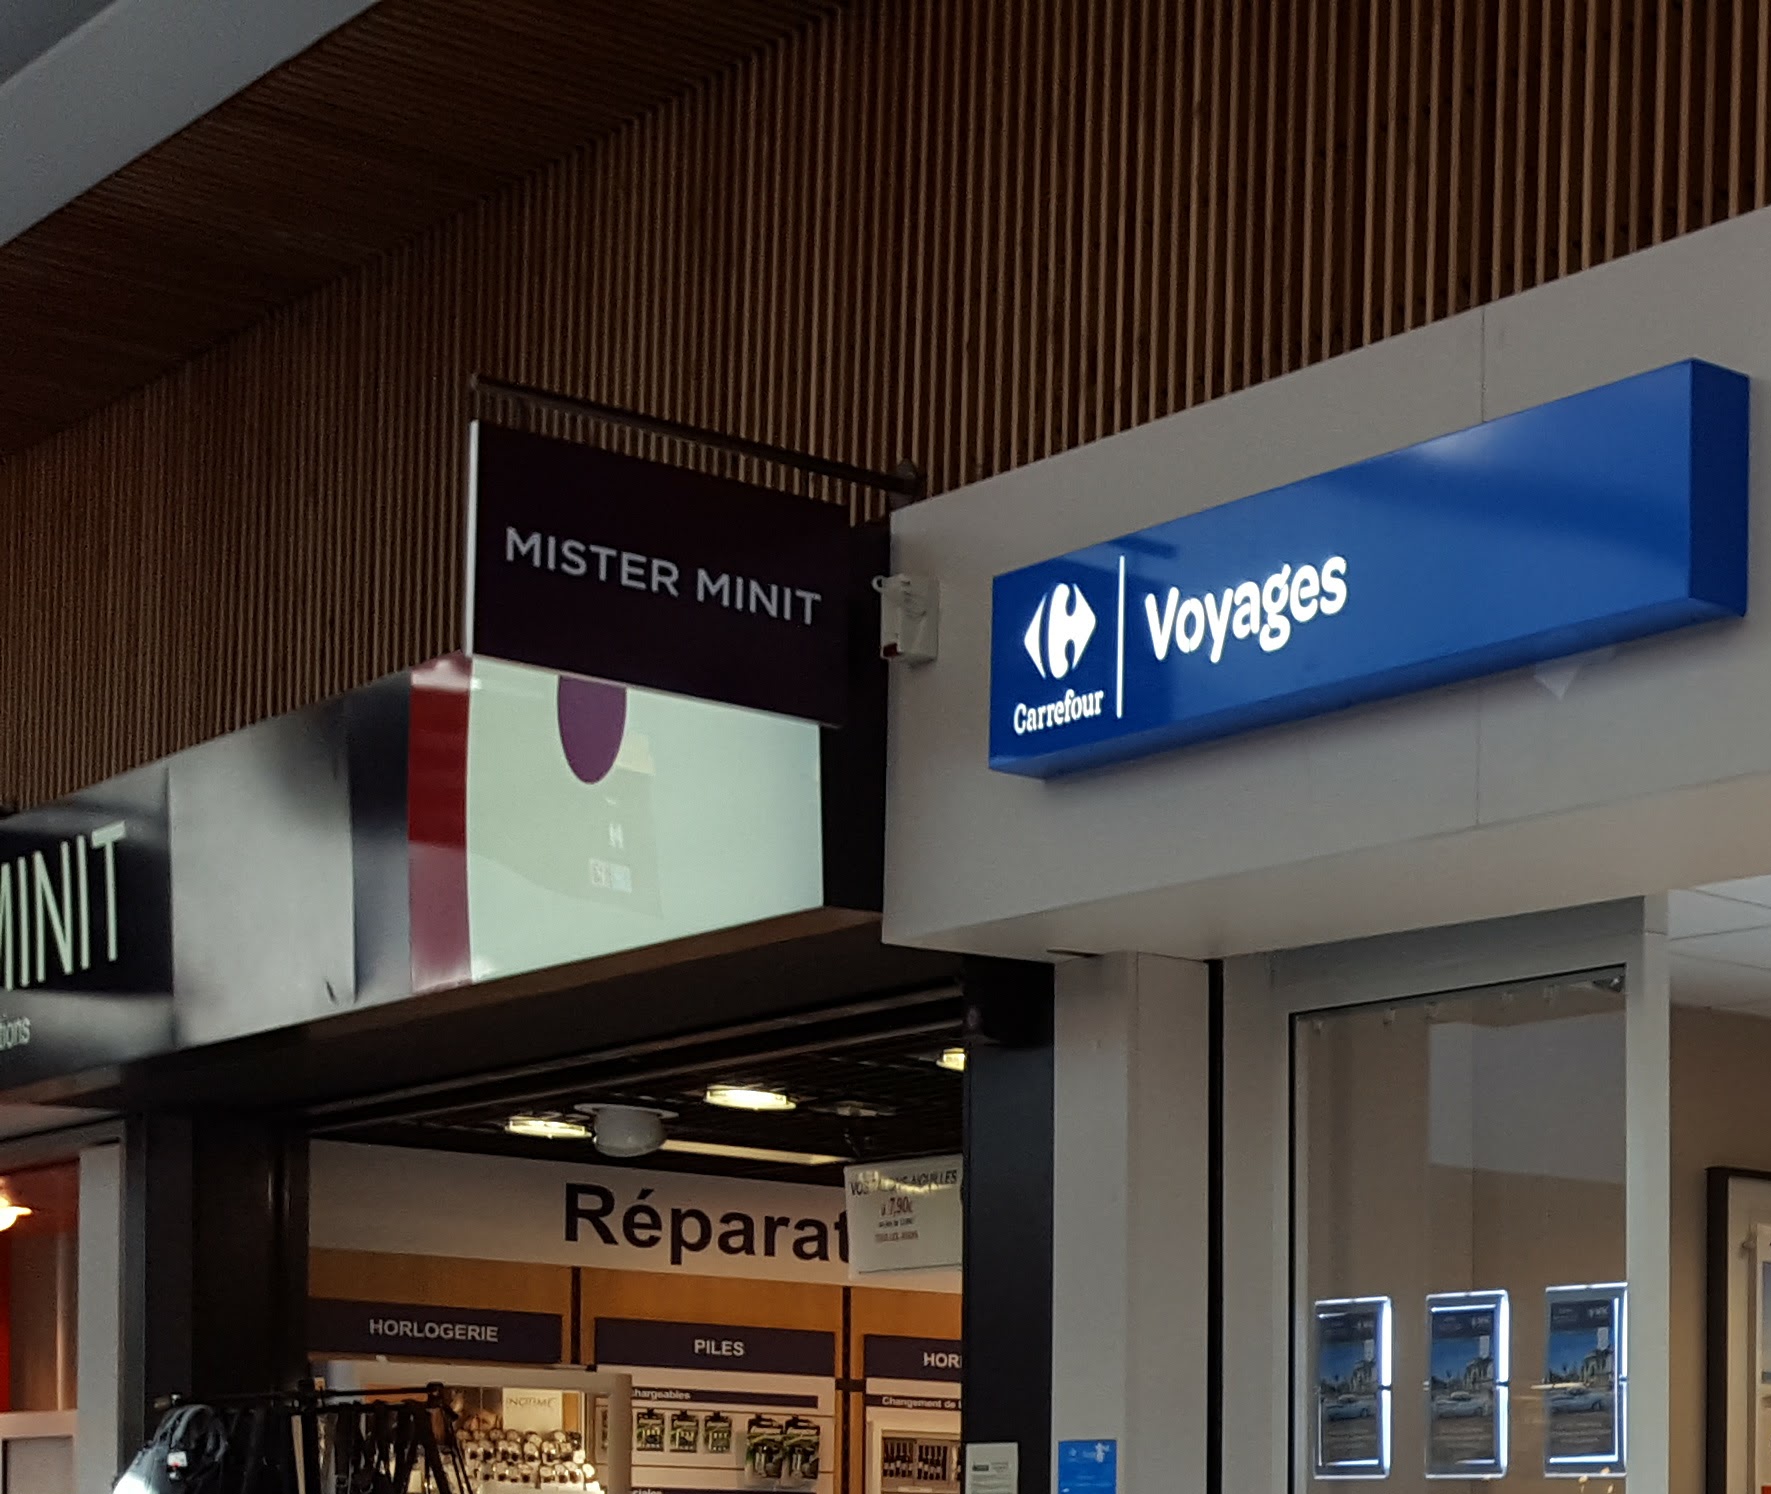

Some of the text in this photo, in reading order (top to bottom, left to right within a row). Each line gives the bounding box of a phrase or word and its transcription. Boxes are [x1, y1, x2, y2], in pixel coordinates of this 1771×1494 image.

[505, 525, 822, 627] MISTER MINIT
[1144, 553, 1348, 665] Voyages
[1013, 688, 1104, 736] Carrefour
[368, 1317, 500, 1344] HORLOGERIE
[693, 1338, 746, 1358] PILES
